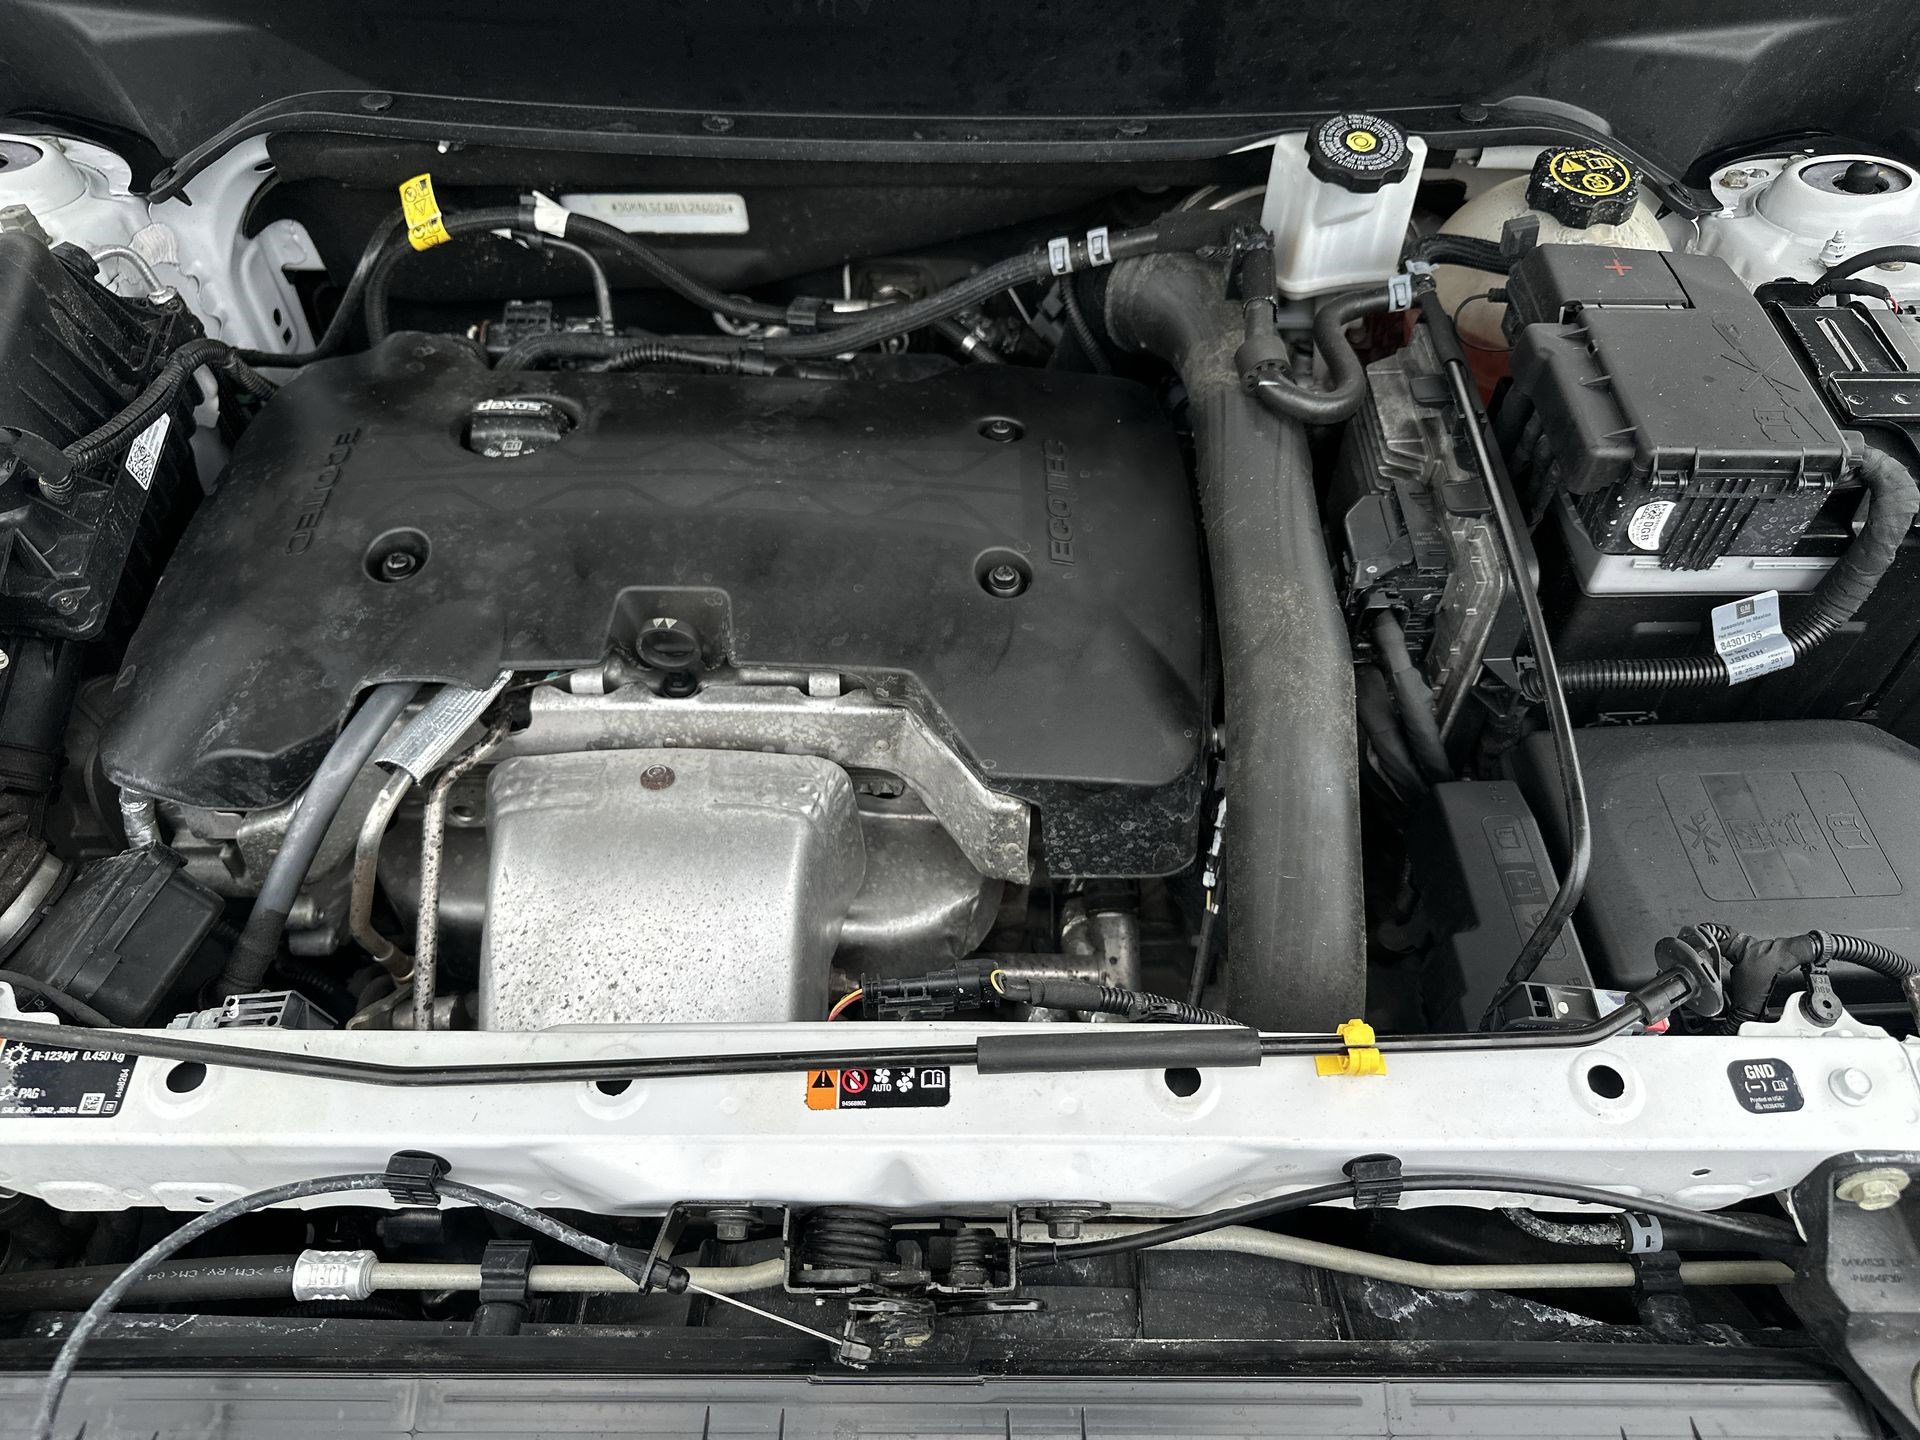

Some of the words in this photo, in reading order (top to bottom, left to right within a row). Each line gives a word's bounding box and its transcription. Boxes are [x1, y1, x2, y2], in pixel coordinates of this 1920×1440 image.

[477, 400, 541, 411] dexos
[1720, 630, 1763, 651] 84301795
[31, 1050, 79, 1063] R-1234yf
[82, 1051, 111, 1061] 0.450
[112, 1052, 126, 1063] kg
[1744, 1063, 1776, 1079] GND
[17, 1087, 41, 1099] PAG
[872, 1083, 892, 1092] AUTO
